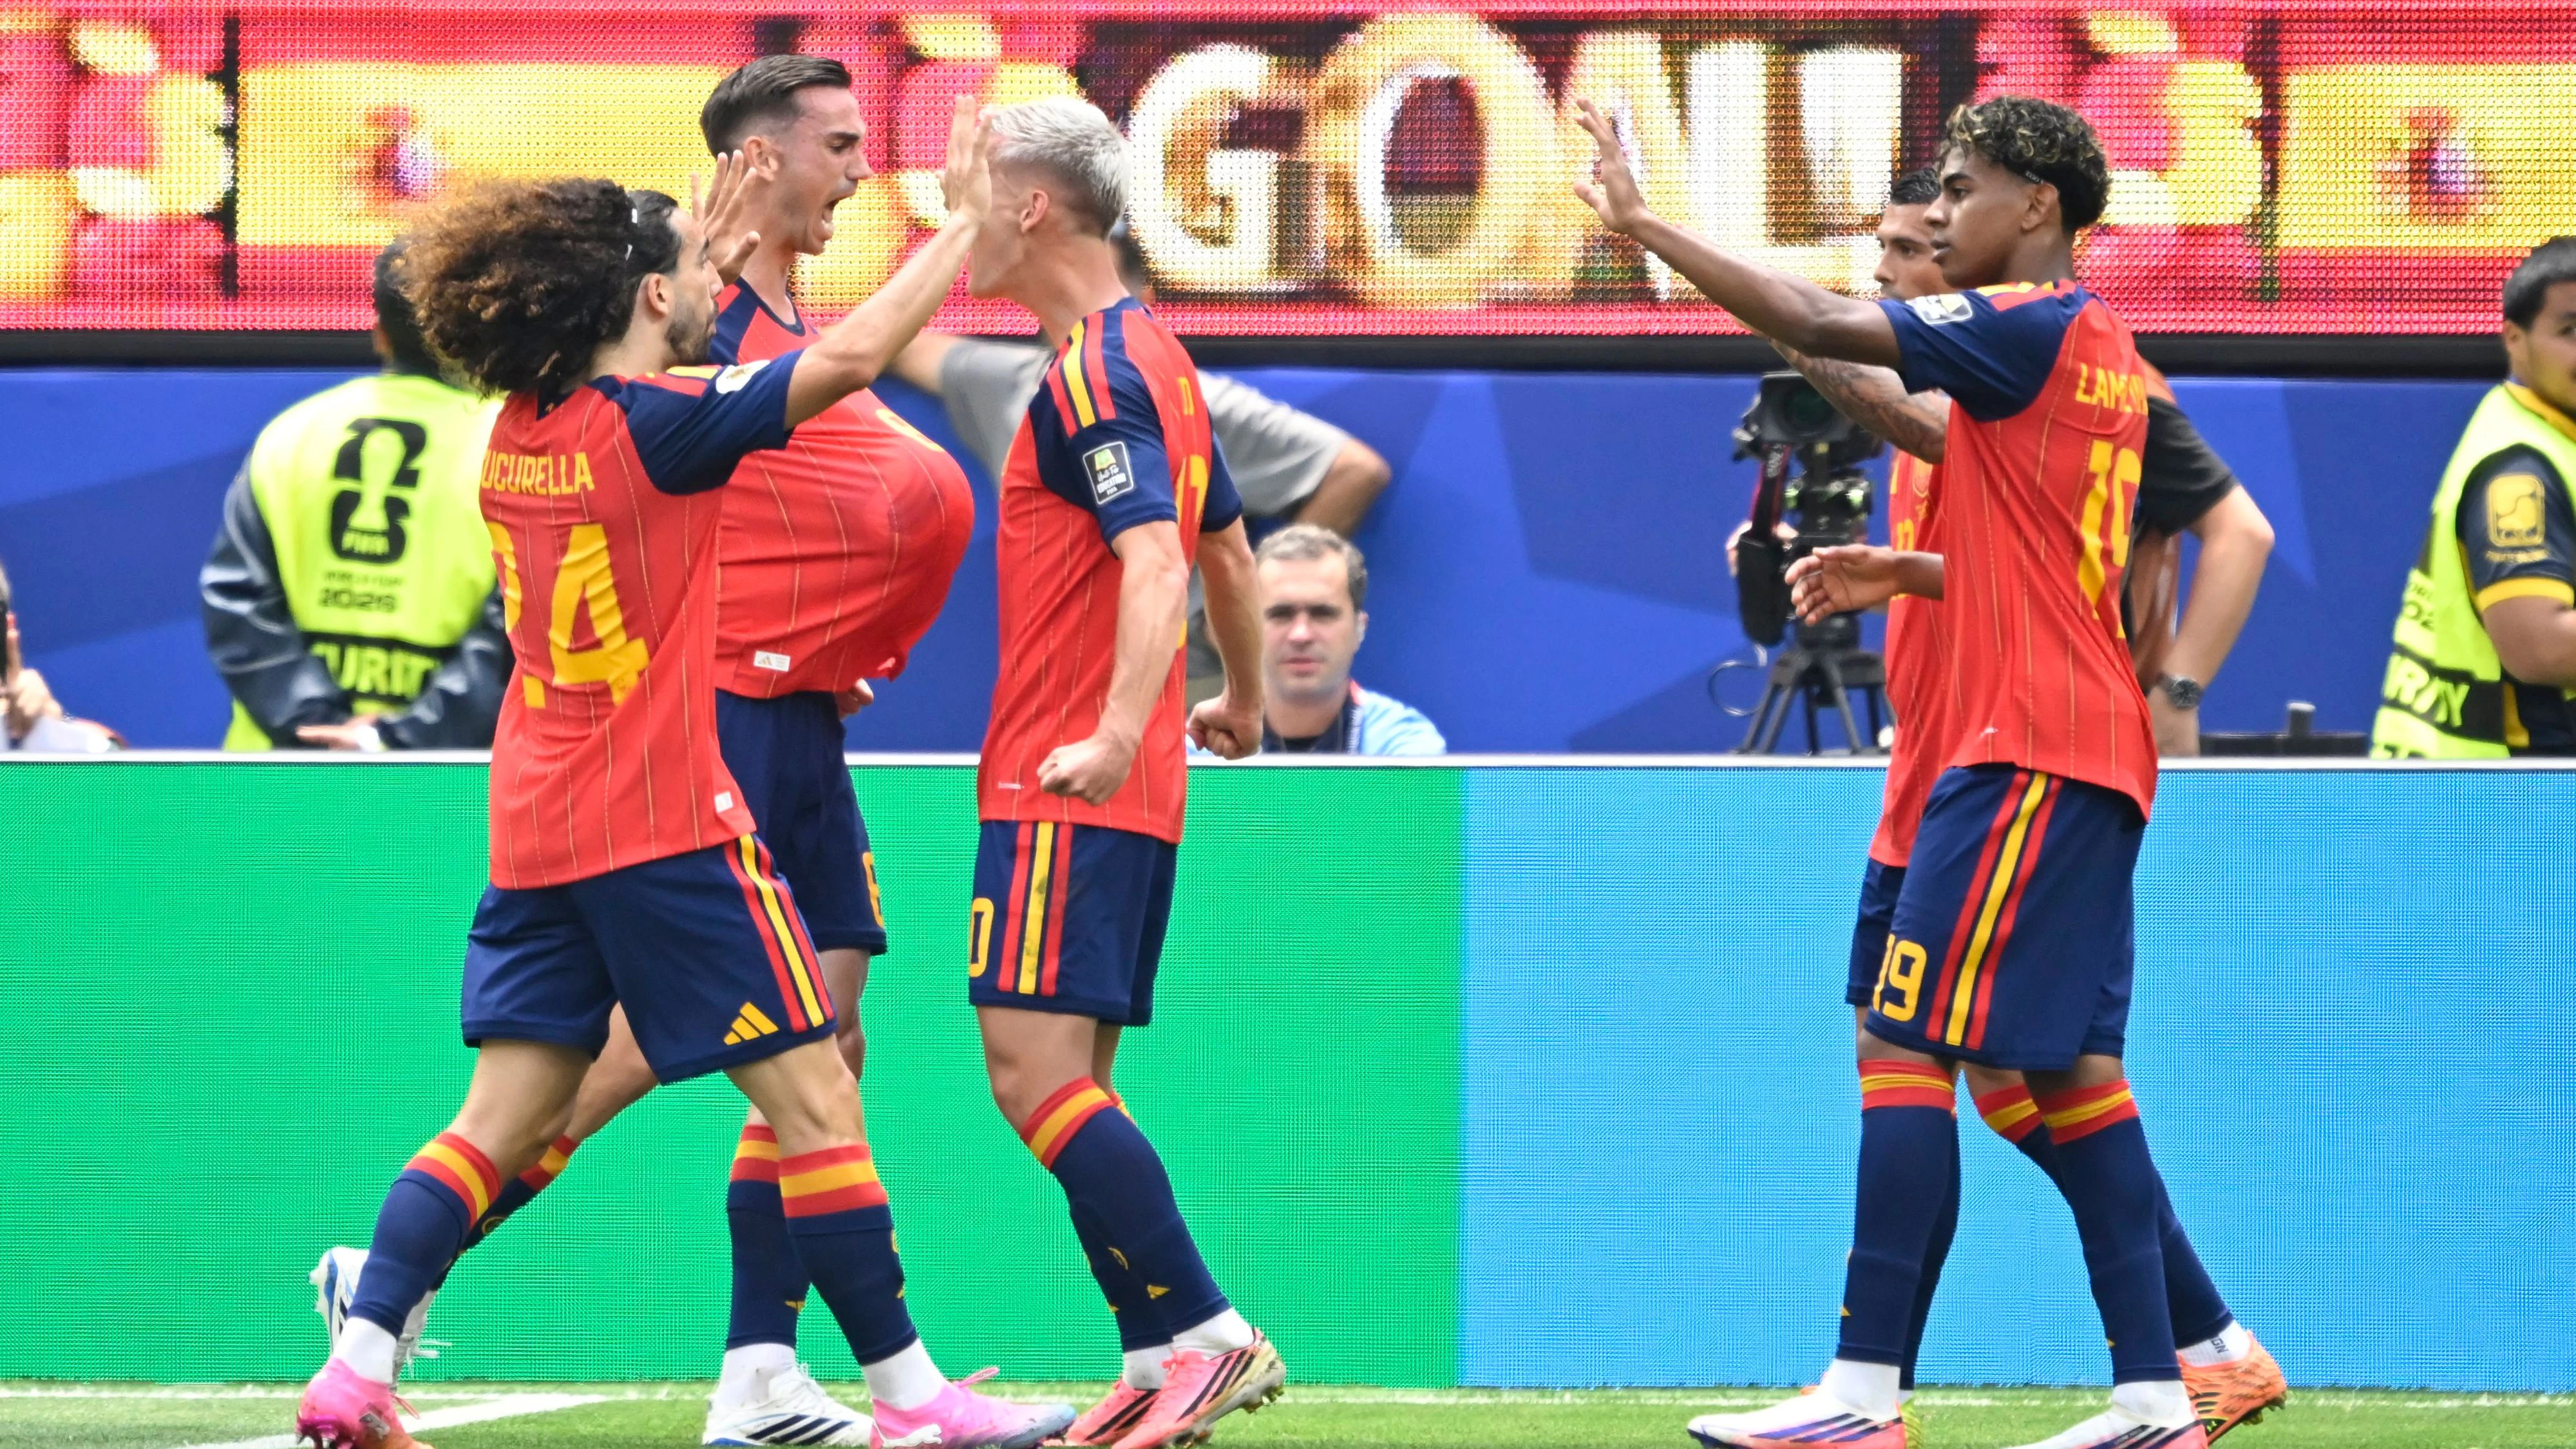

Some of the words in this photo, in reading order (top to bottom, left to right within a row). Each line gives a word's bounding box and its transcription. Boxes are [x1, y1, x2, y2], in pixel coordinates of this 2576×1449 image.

[1128, 10, 1904, 308] GOAL!
[319, 588, 395, 613] 2026
[1873, 934, 1927, 1022] 19
